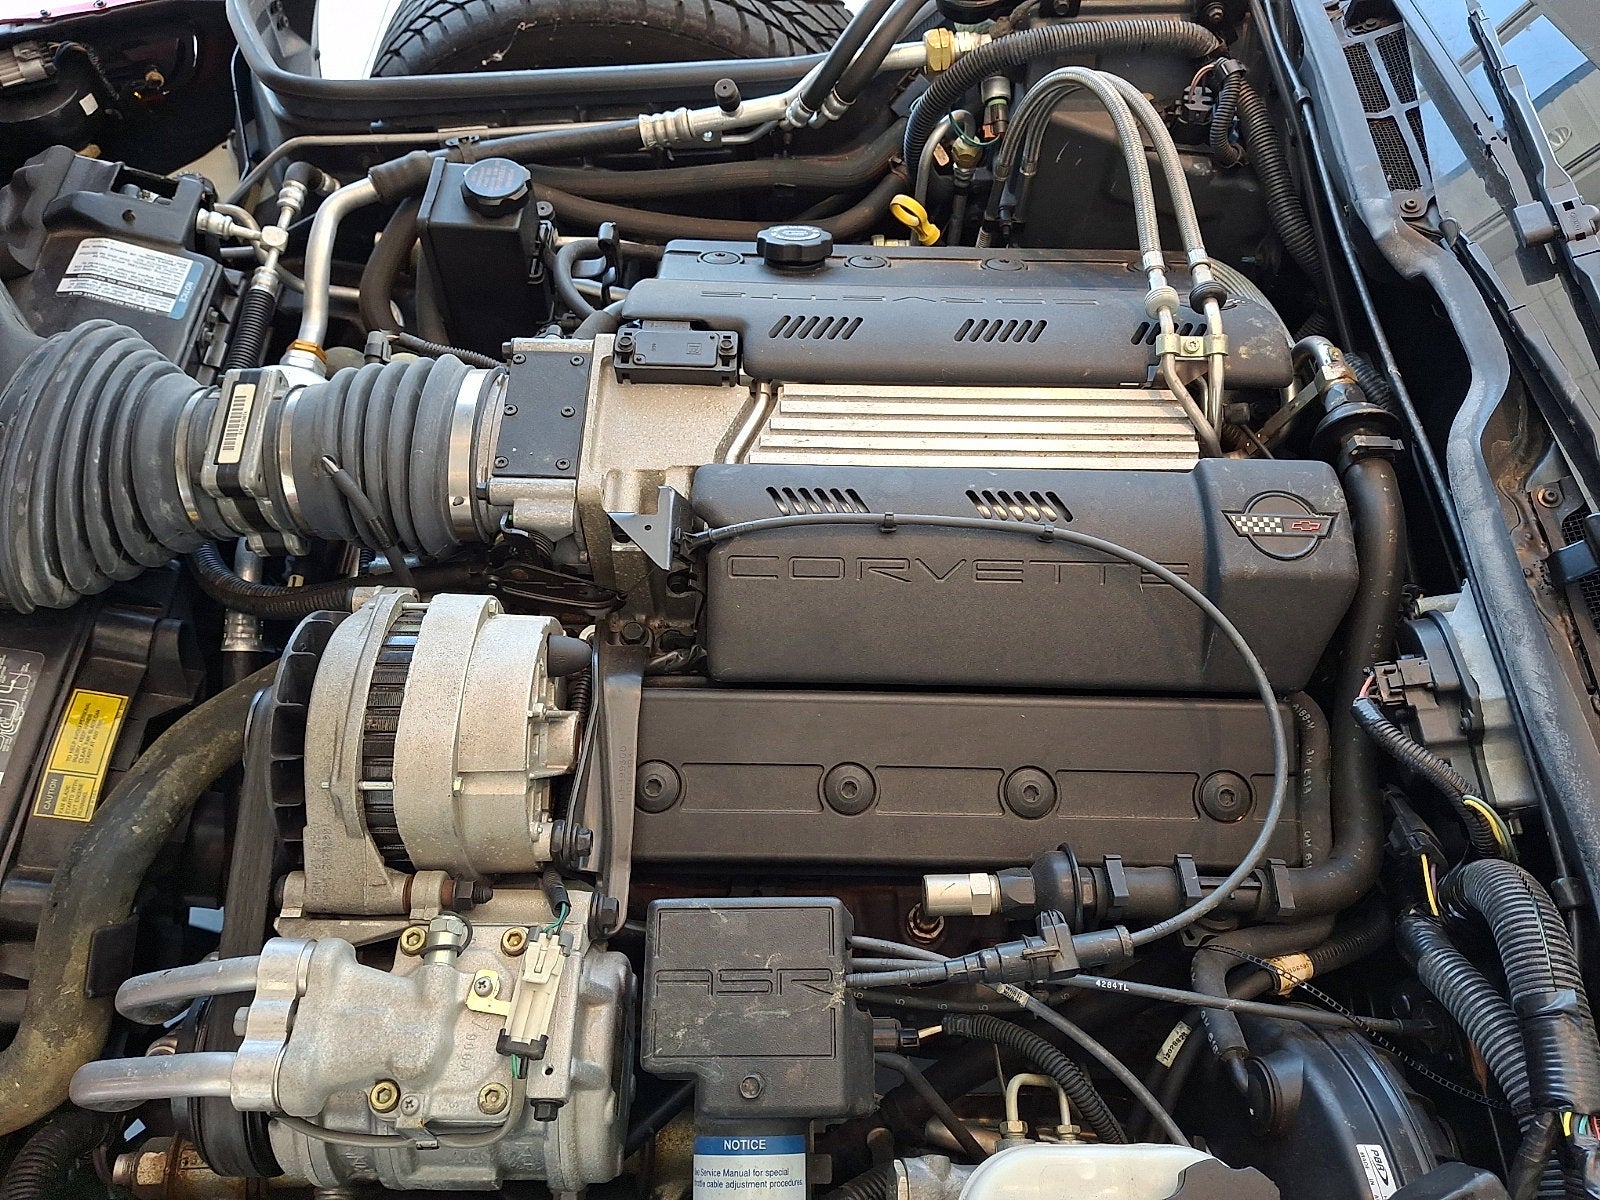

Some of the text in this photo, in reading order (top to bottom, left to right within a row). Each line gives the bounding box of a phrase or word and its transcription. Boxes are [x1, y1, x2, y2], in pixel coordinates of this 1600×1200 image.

[726, 555, 1190, 585] CORVETTE
[43, 778, 59, 811] CAUTION
[654, 968, 834, 997] ASR
[1095, 979, 1129, 992] 4284TL
[723, 1139, 766, 1150] NOTICE
[700, 1168, 721, 1178] Service
[722, 1168, 750, 1177] Manual
[753, 1168, 762, 1177] for
[765, 1168, 789, 1178] special
[706, 1180, 723, 1188] cable
[725, 1180, 768, 1190] adjustment
